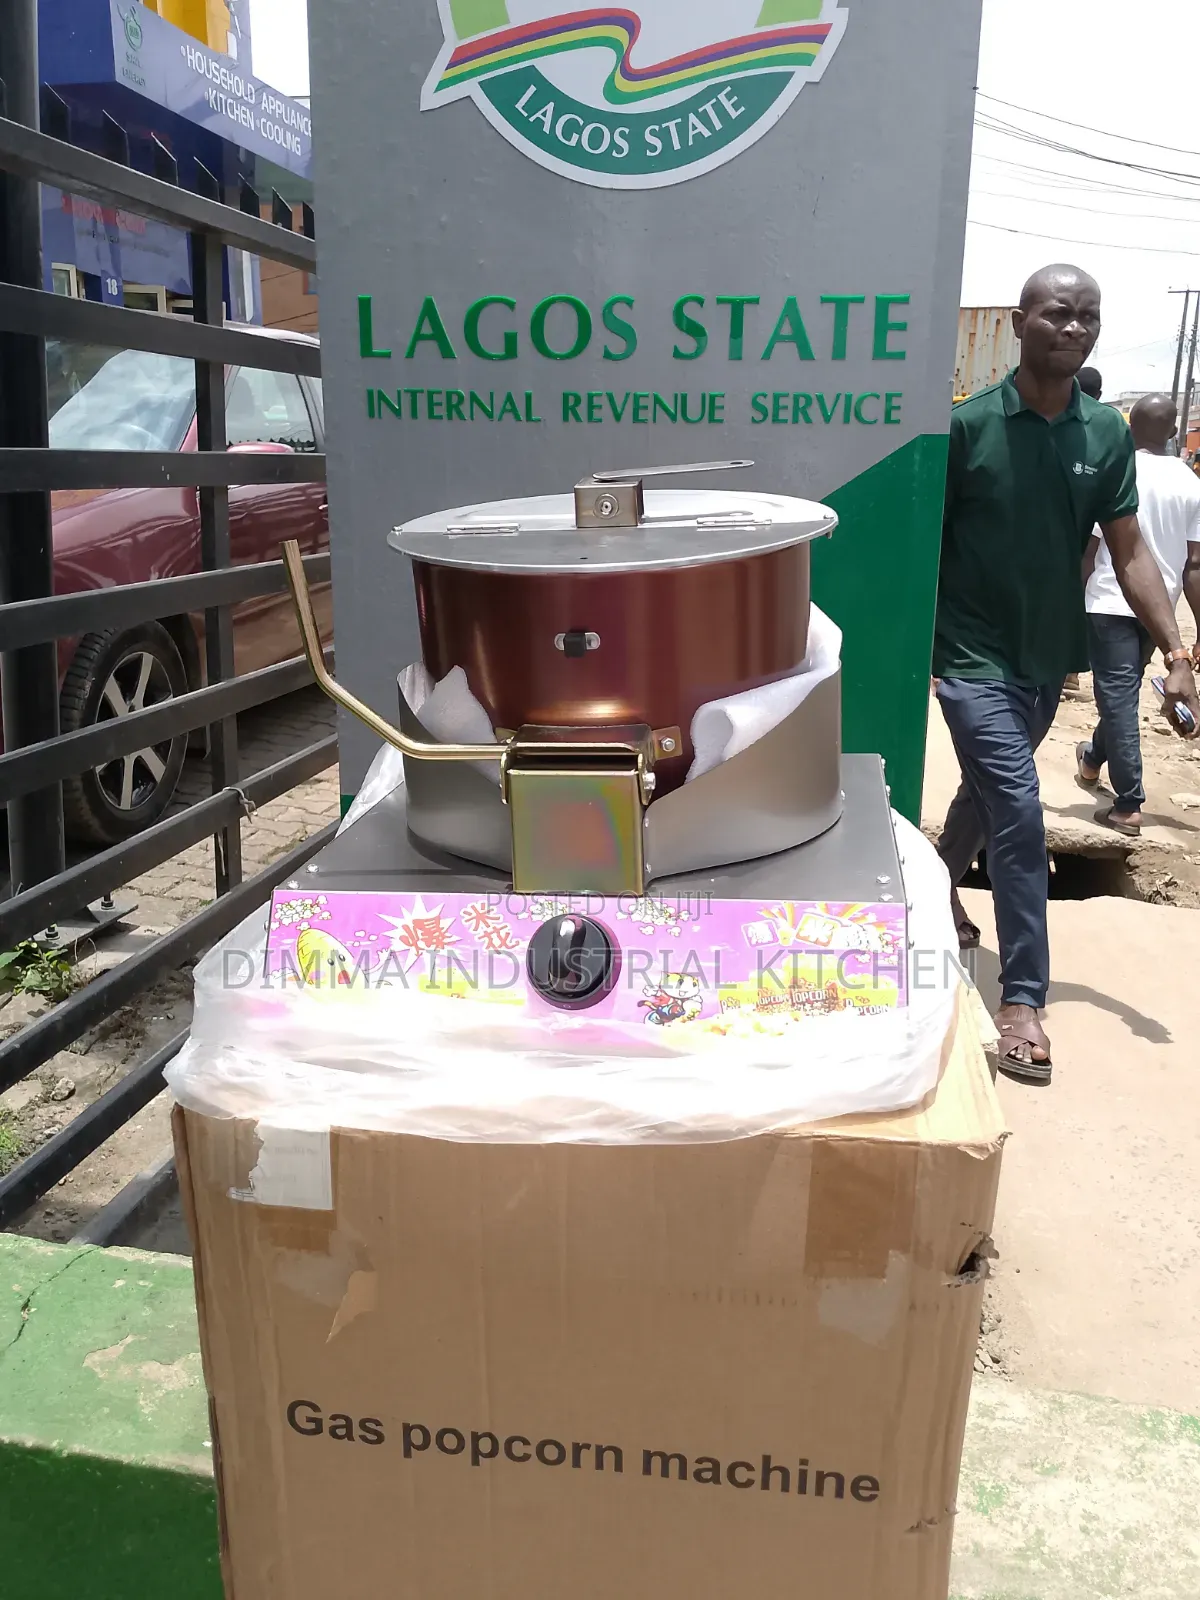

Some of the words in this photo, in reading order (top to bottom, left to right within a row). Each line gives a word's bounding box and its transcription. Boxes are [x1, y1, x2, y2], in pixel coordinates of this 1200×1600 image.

[186, 45, 256, 105] HOUSEHOLD
[208, 87, 254, 131] KITCHEN
[260, 117, 302, 156] COOLING
[513, 84, 630, 158] LAGOS
[645, 86, 746, 157] STATE
[106, 277, 119, 296] 18
[357, 294, 638, 361] LAGOS
[671, 293, 911, 361] STATE
[365, 387, 542, 421] INTERNAL
[562, 391, 726, 424] REVENUE
[750, 391, 903, 424] SERVICE
[286, 1399, 385, 1445] Gas
[401, 1419, 625, 1473] popcorn
[641, 1445, 881, 1503] machine
